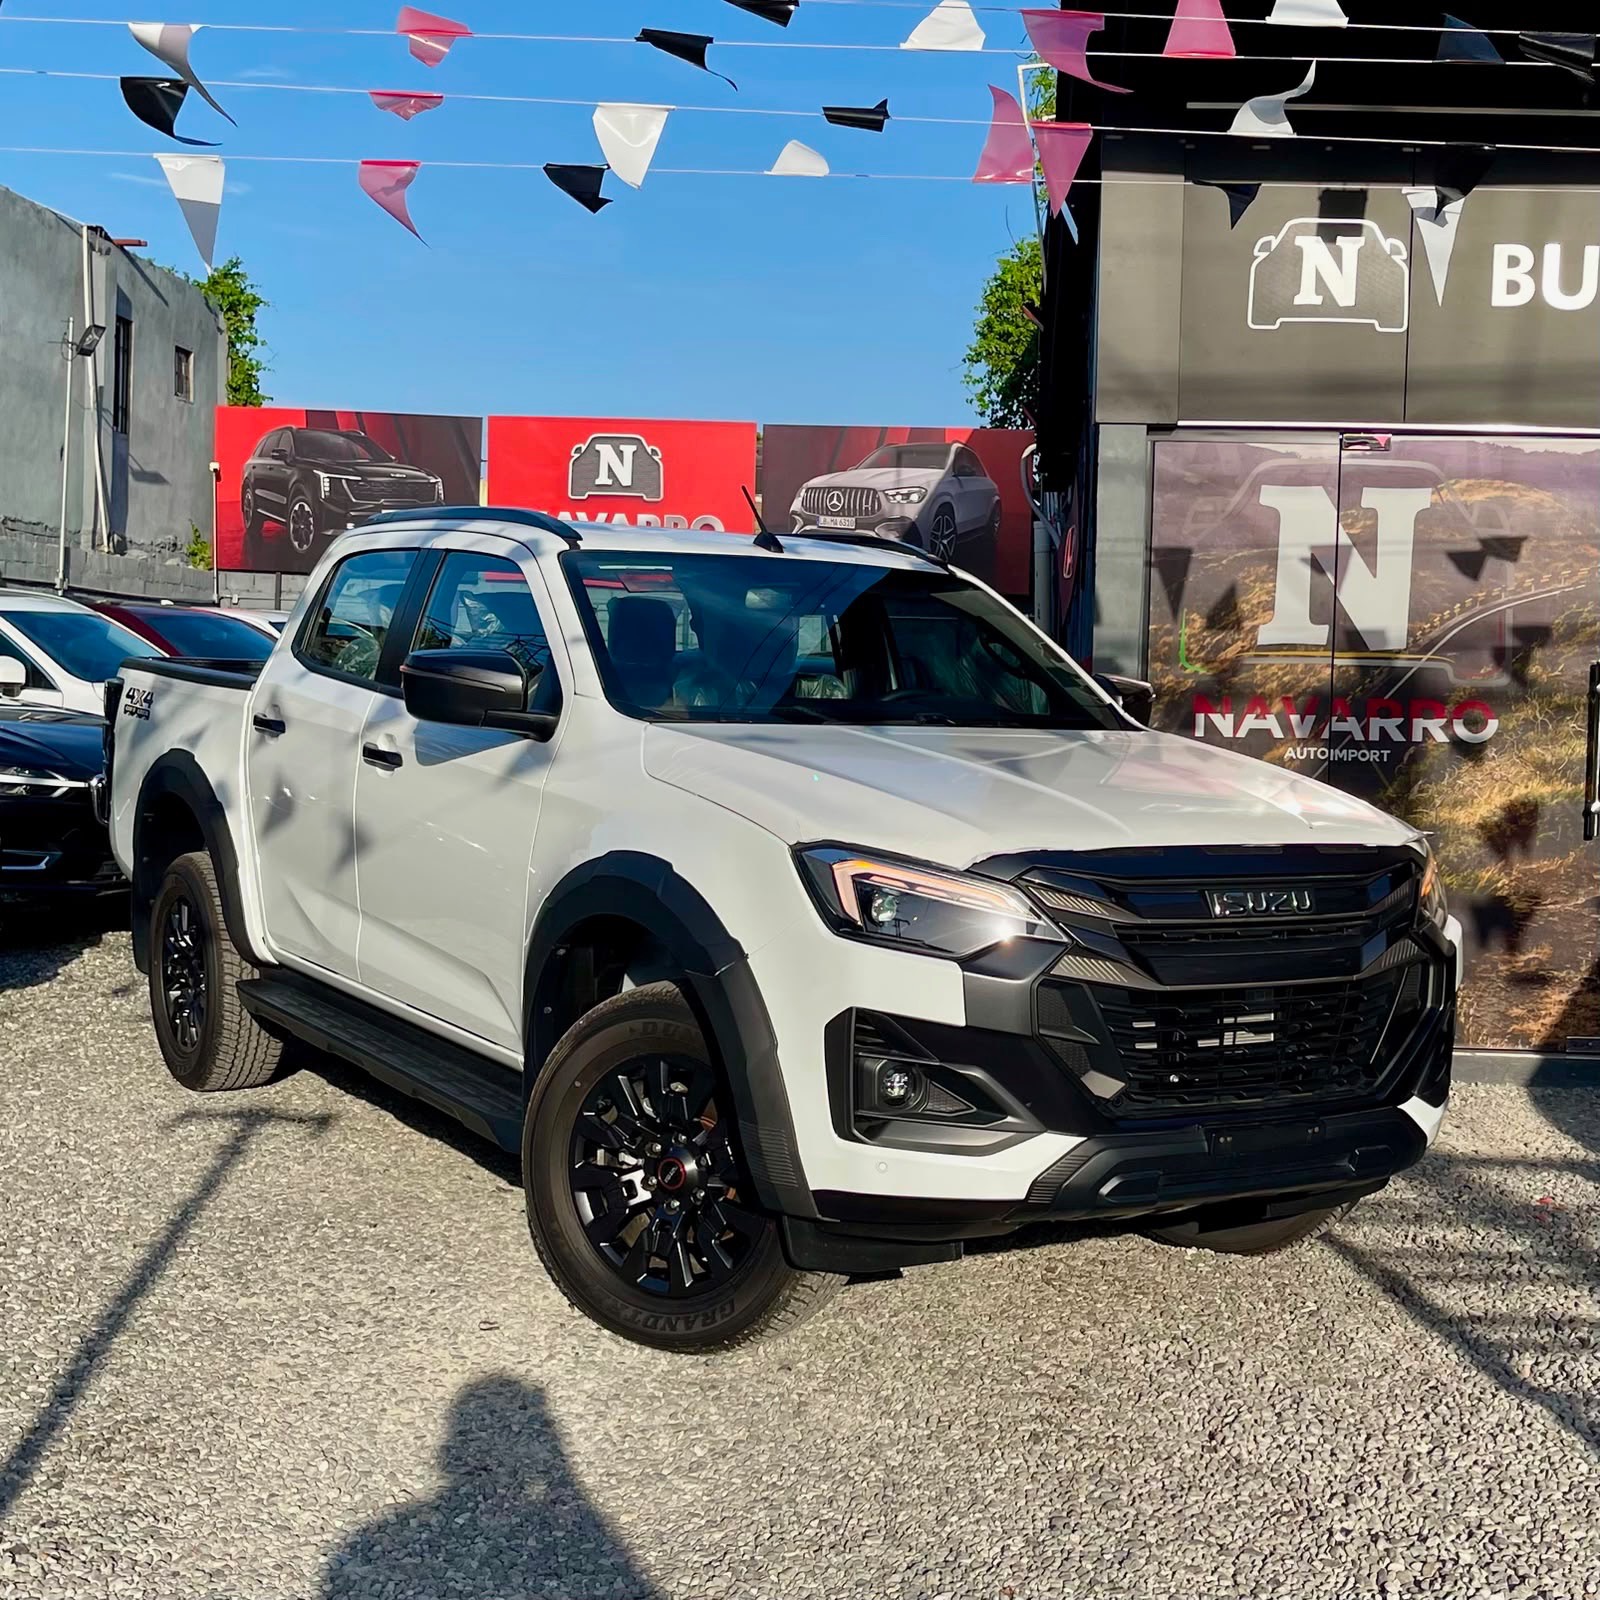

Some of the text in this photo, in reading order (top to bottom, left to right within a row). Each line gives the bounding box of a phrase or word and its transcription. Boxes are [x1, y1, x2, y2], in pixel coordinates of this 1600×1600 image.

[1293, 235, 1365, 307] N
[1490, 243, 1600, 310] BU
[594, 443, 638, 487] N
[1256, 484, 1433, 651] N
[1191, 694, 1500, 744] NAVARRO
[1283, 747, 1391, 763] AUTOIMPORT
[1209, 889, 1313, 917] ISUZU
